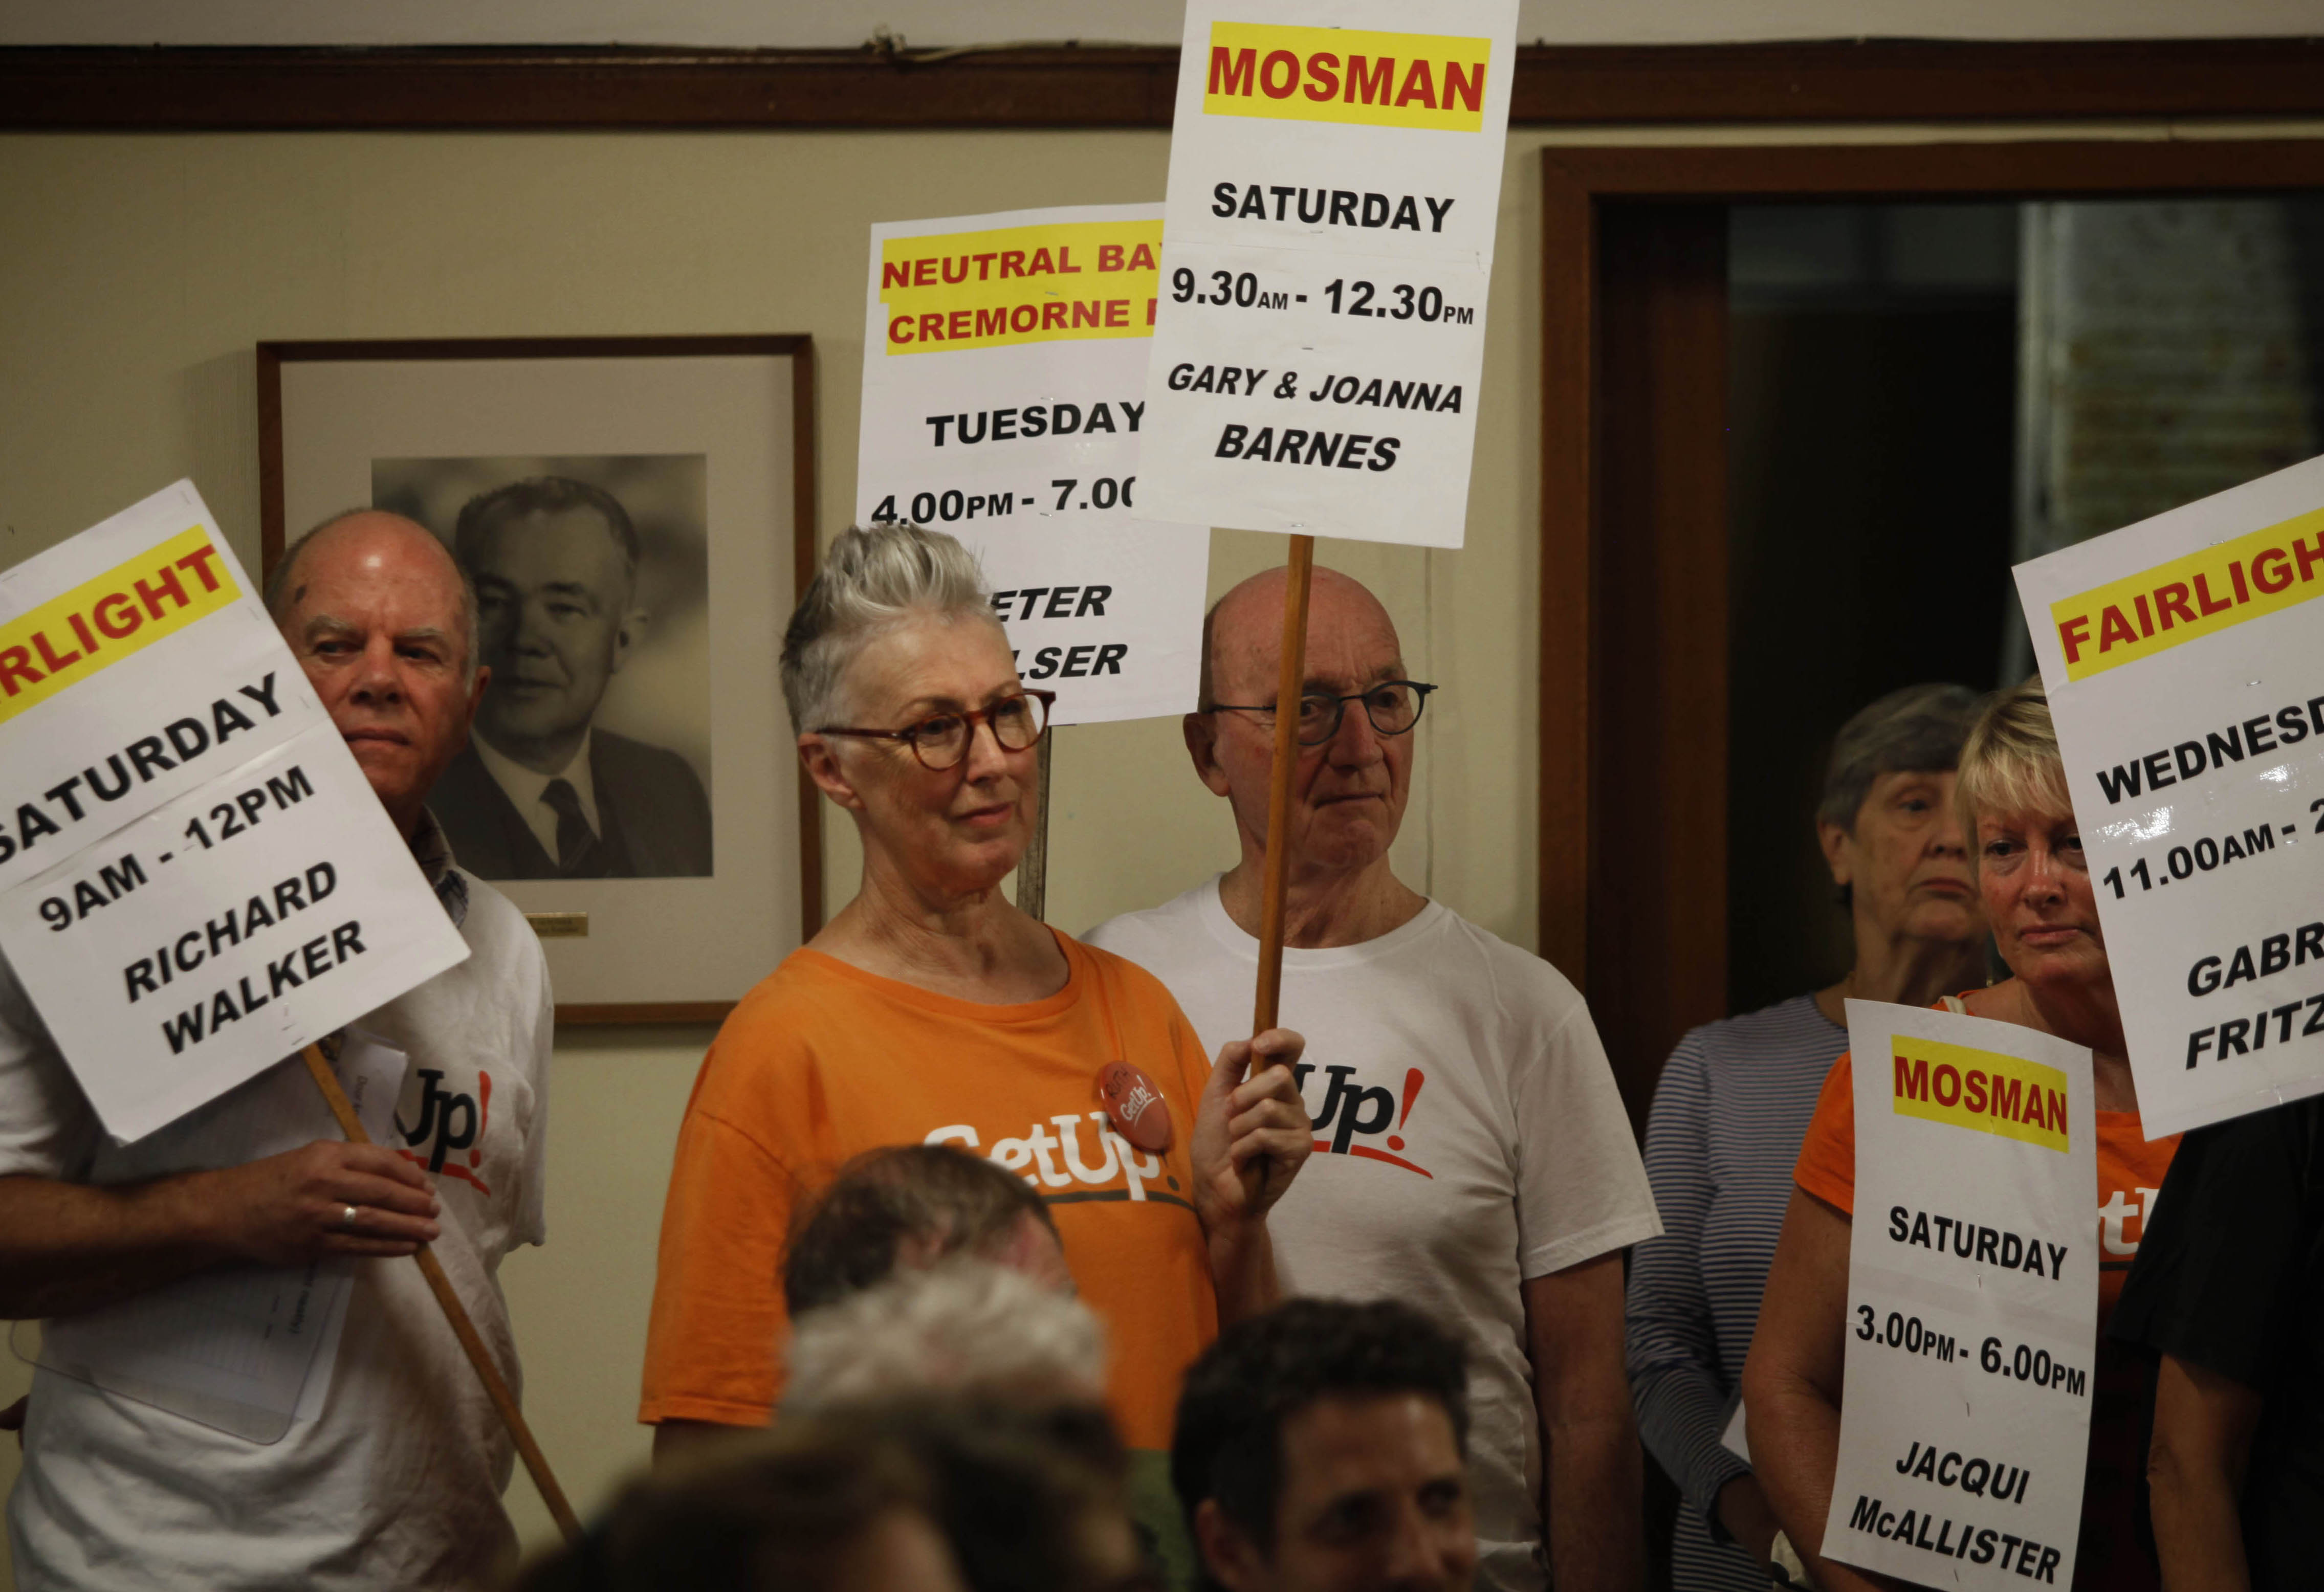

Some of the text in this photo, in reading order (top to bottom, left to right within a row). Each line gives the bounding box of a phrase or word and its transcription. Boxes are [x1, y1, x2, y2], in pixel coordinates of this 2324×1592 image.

[1208, 47, 1485, 112] MOSMAN
[1212, 182, 1455, 233] SATURDAY
[882, 242, 1162, 289] NEUTRAL BA
[889, 300, 1130, 344] CREMORNE
[1324, 279, 1474, 325] 12.30PM
[1168, 363, 1462, 413] GARY & JOANNA
[926, 401, 1145, 447] TUESDAY
[1215, 424, 1401, 472] BARNES
[0, 544, 222, 697] RLIGHT
[990, 585, 1112, 622] ETER
[2058, 530, 2324, 665] FAIRLIGH
[39, 854, 148, 932] 9AM
[185, 766, 315, 850] 12PM
[124, 861, 337, 1003] RICHARD
[2187, 921, 2324, 997] GABR
[162, 920, 366, 1055] WALKER
[2186, 994, 2324, 1071] FRITZ
[1120, 1075, 1151, 1121] GetUp!
[1293, 1064, 1425, 1155] Up!
[1894, 1055, 2067, 1135] MOSMAN
[1889, 1206, 2068, 1281] SATURDAY
[1981, 1337, 2086, 1396] 6.00PM
[1896, 1442, 2030, 1504] JACQUI
[1849, 1495, 2061, 1584] McALLISTER
